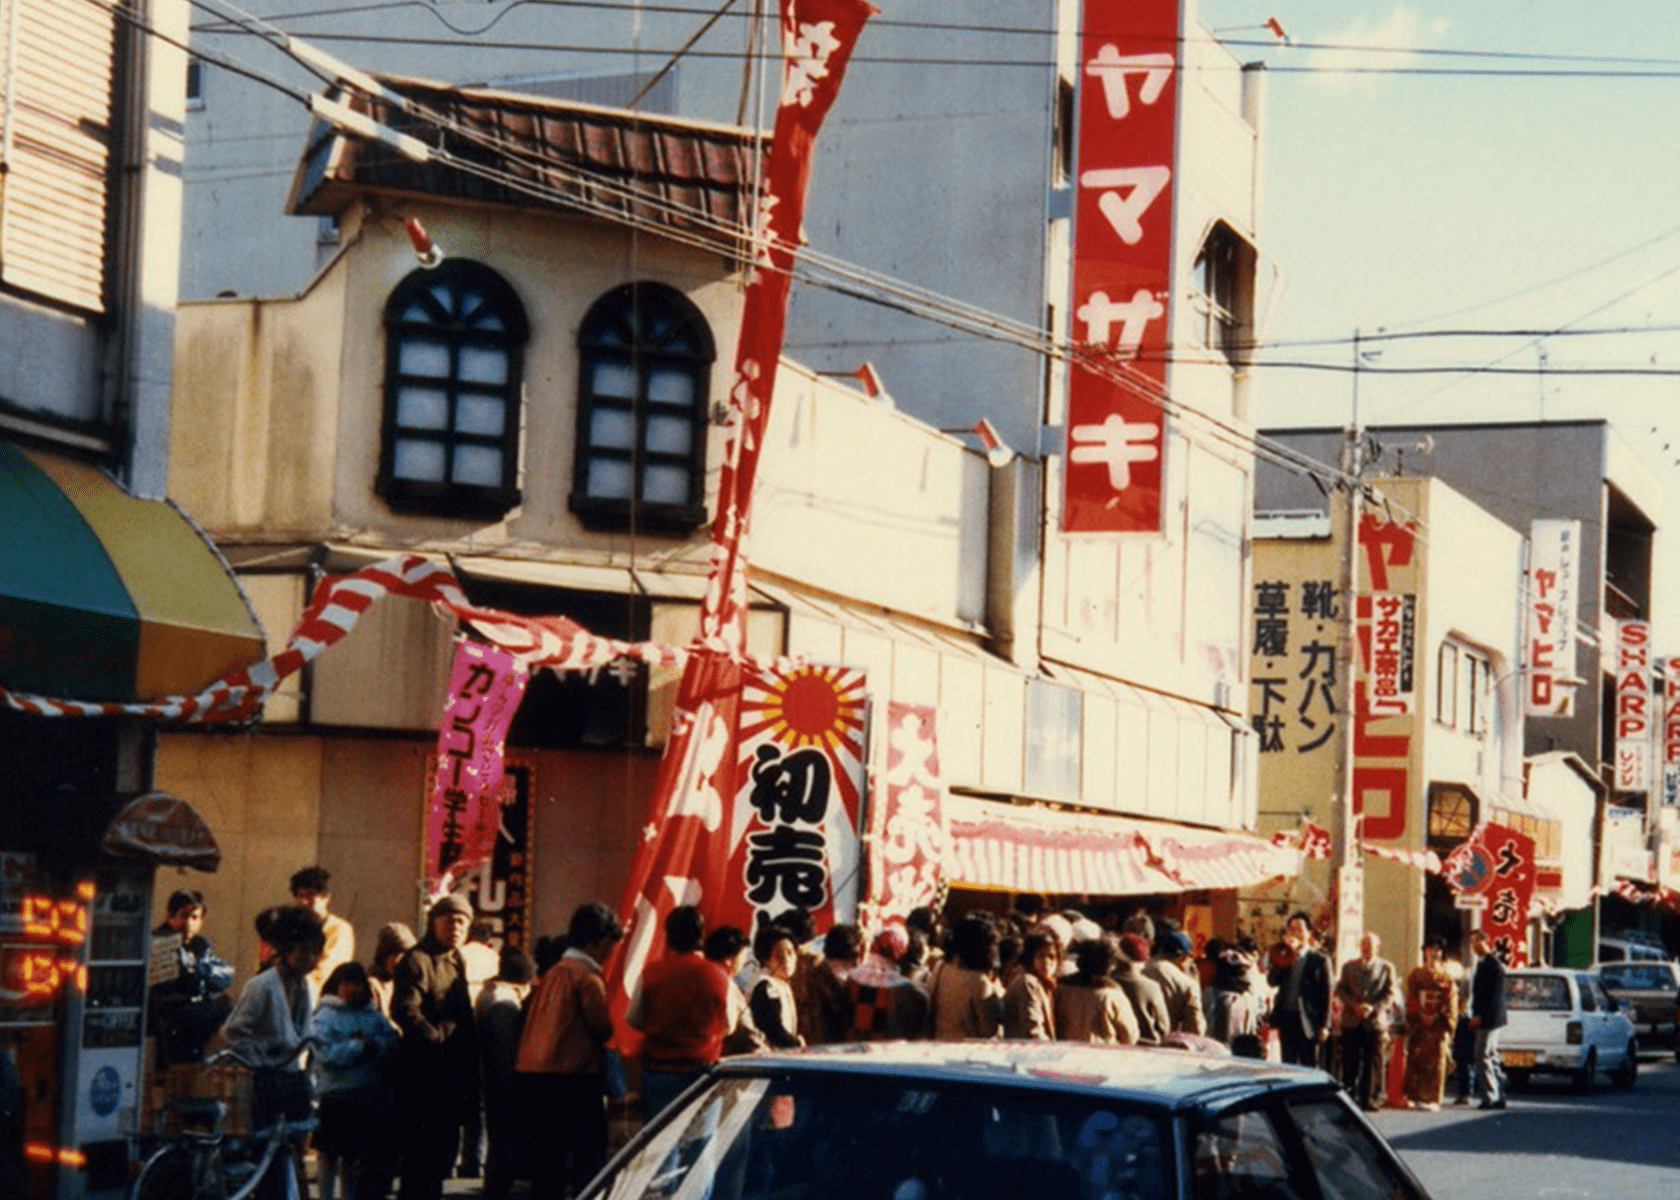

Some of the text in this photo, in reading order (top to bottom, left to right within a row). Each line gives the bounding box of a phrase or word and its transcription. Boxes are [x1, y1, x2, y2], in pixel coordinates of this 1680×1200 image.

[1070, 43, 1175, 491] ヤマザキ
[1251, 581, 1291, 754] 草履・下駄
[1374, 596, 1402, 697] サカエ薬品
[1531, 567, 1556, 706] ヤマヒロ
[1619, 623, 1648, 738] SHARP
